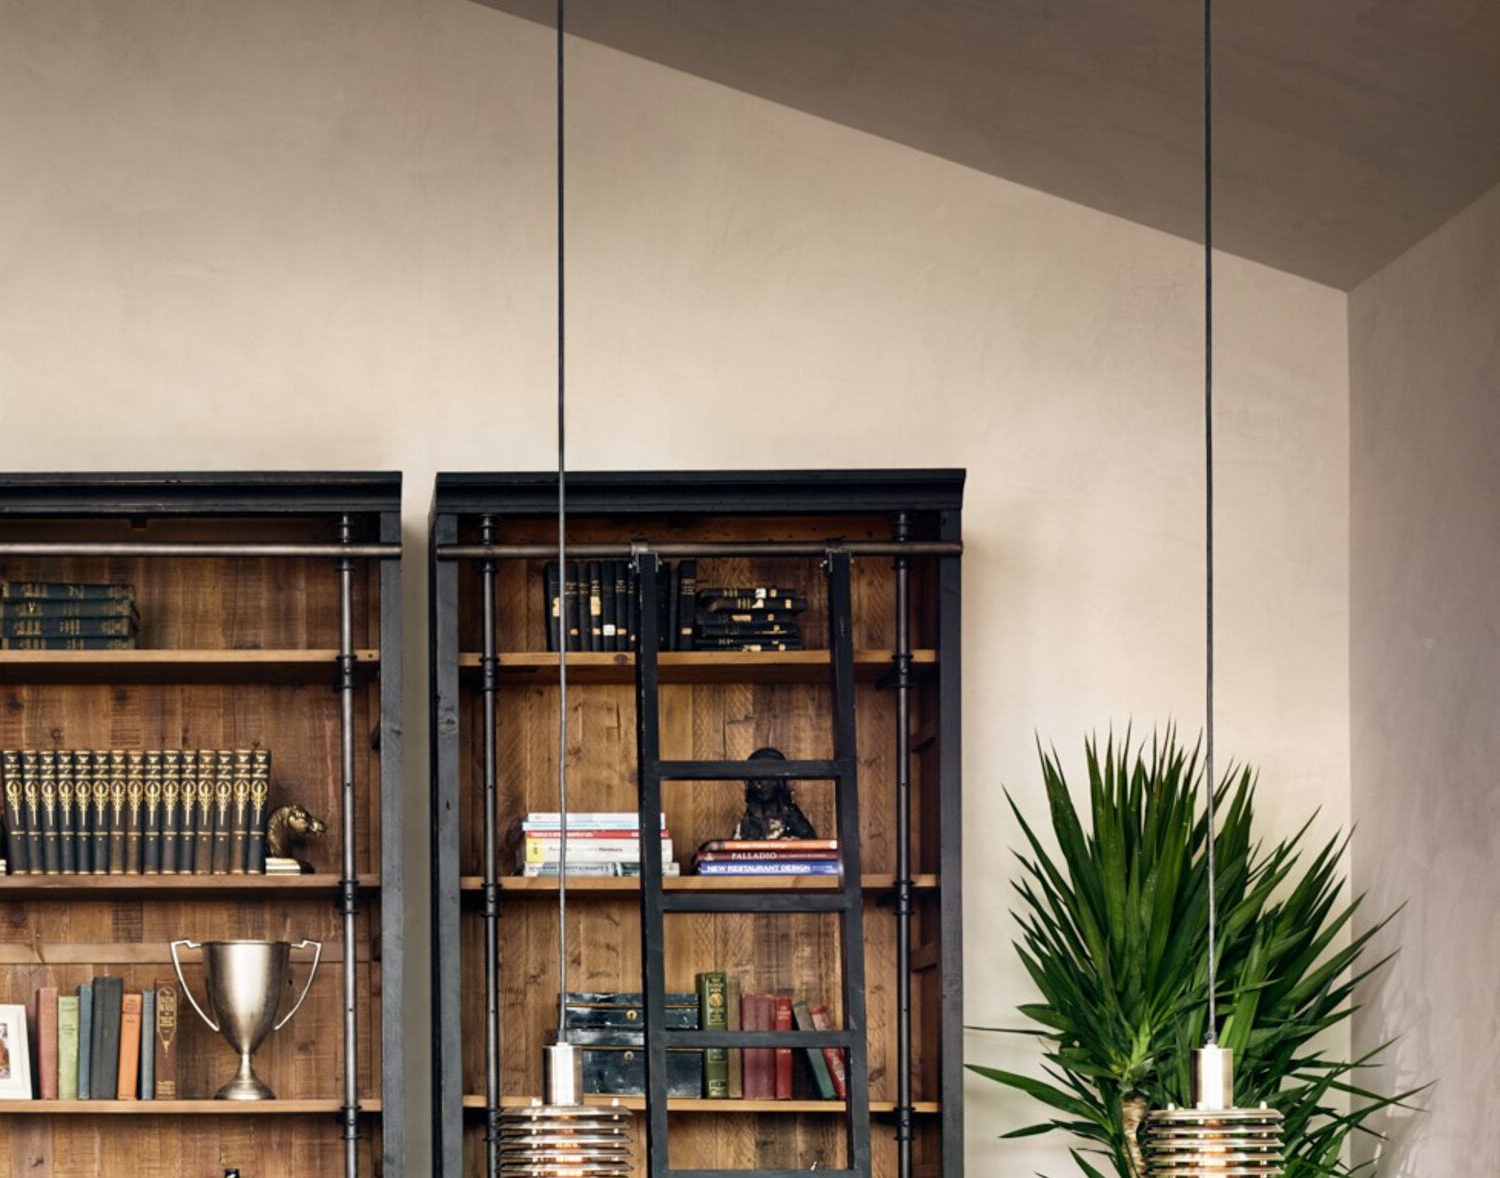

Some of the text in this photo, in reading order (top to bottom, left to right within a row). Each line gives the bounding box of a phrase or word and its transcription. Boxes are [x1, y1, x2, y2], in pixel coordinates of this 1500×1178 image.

[732, 852, 777, 860] PALLADIO
[707, 865, 727, 873] NEW
[728, 865, 779, 873] RESTAURANT
[781, 865, 811, 873] DESIGN
